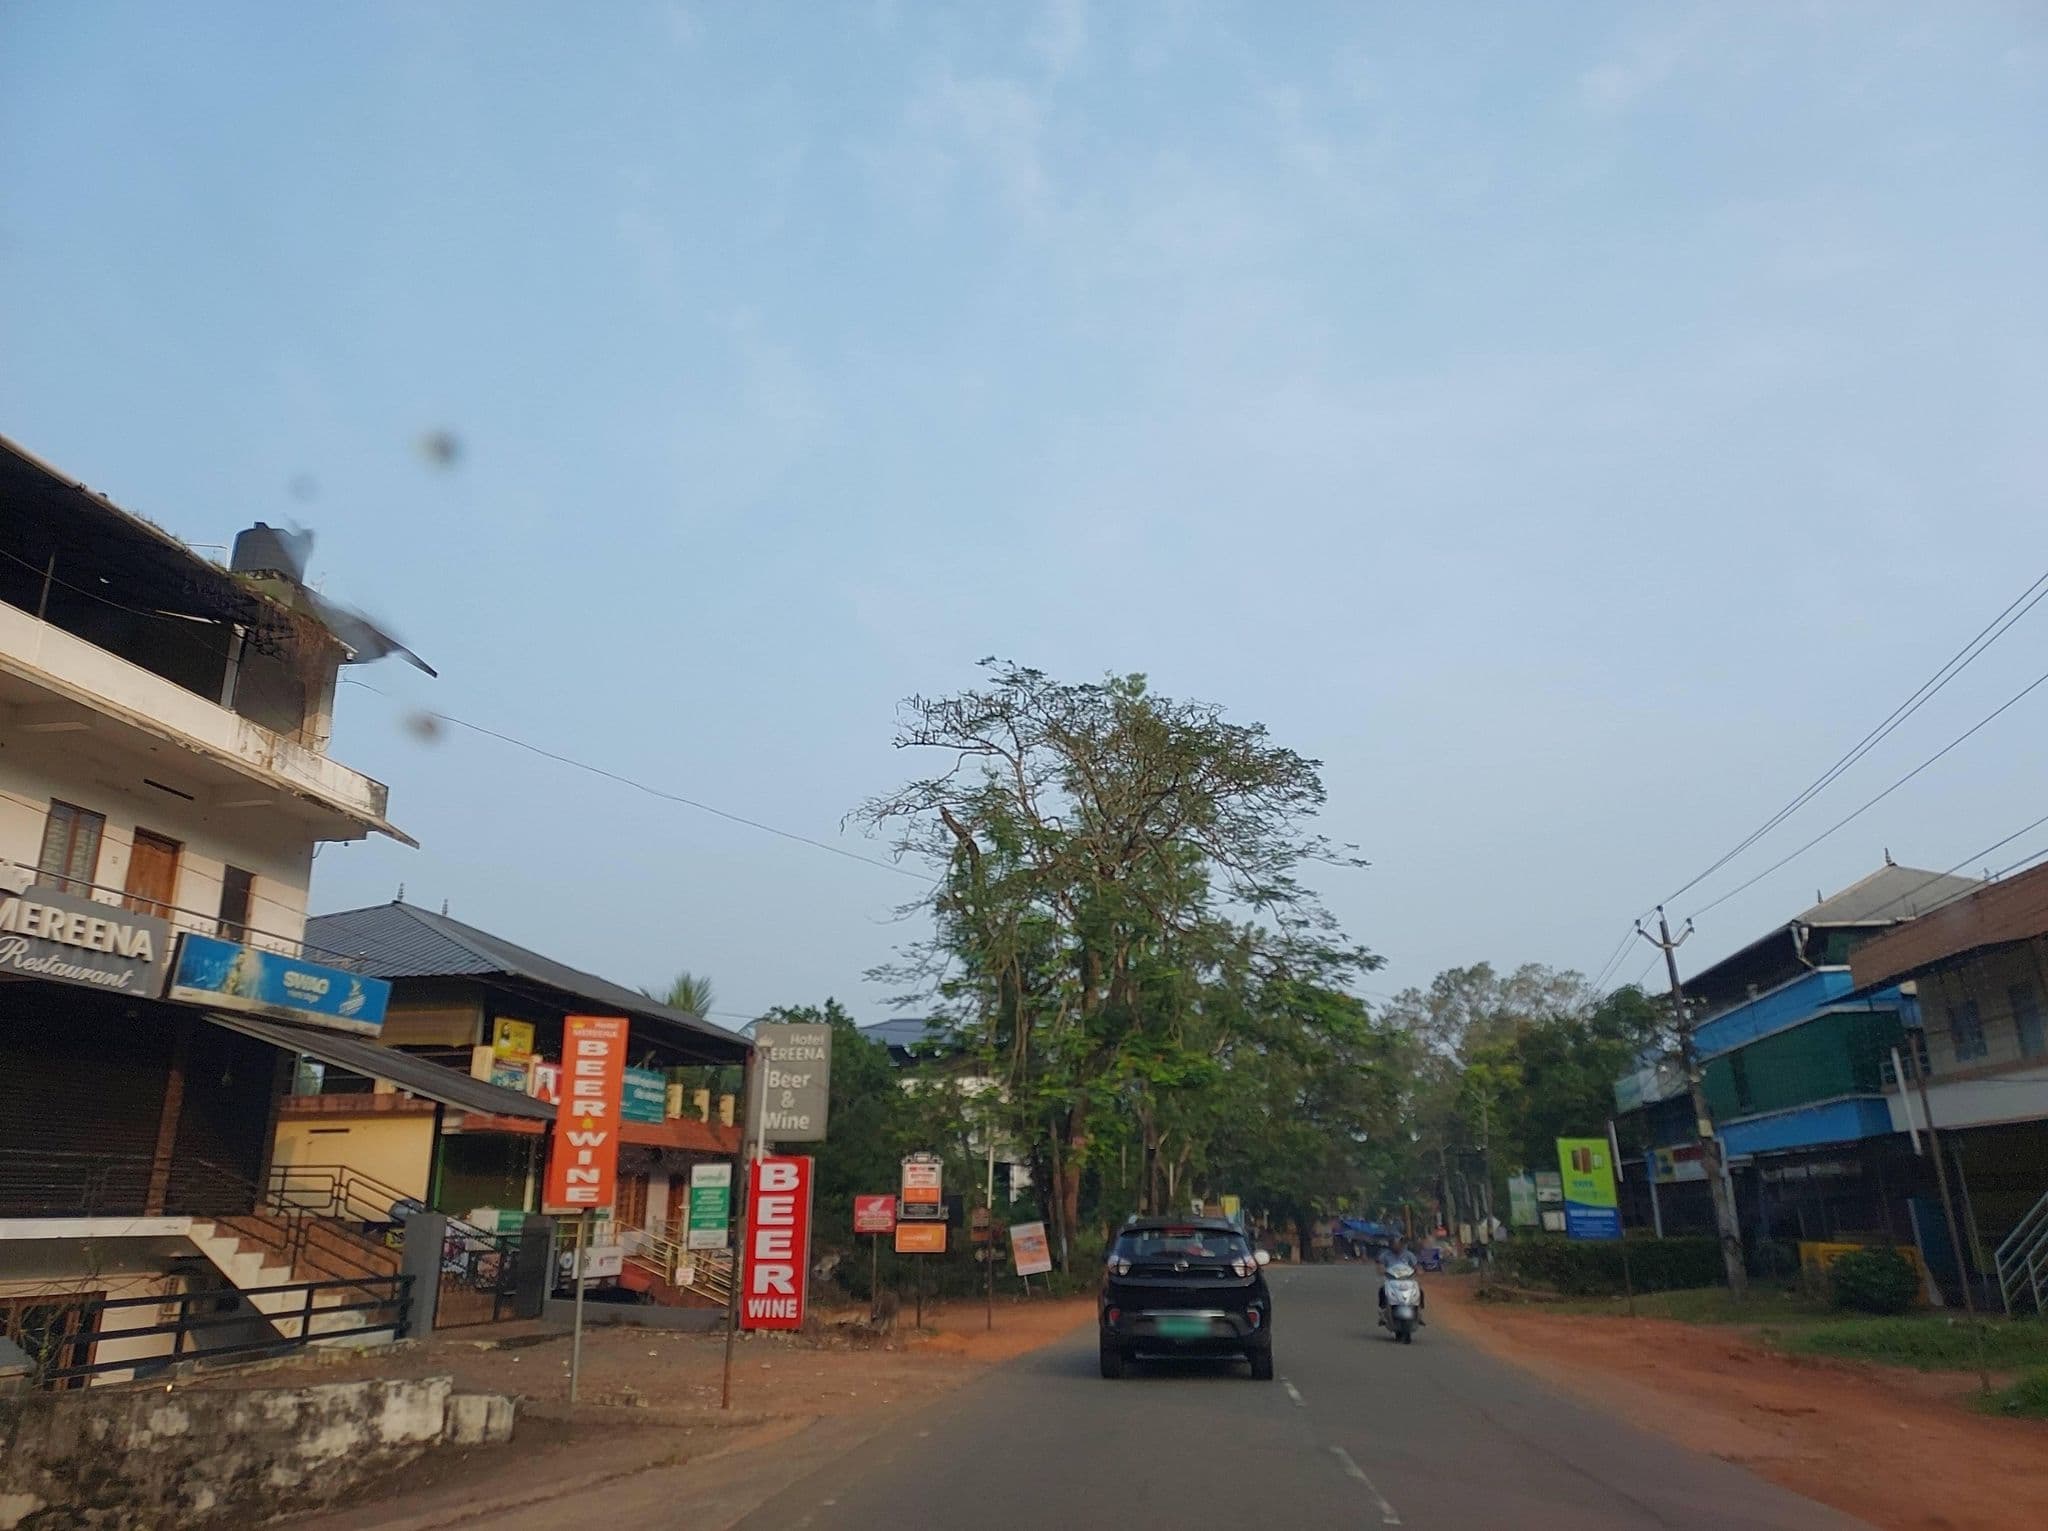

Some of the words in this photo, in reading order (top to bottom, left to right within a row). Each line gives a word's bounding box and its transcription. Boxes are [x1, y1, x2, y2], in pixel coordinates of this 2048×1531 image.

[0, 936, 134, 988] Restaurant
[790, 1033, 824, 1046] Hotel
[761, 1046, 825, 1061] EREENA
[572, 1039, 609, 1118] BEER
[769, 1071, 811, 1088] Beer
[780, 1090, 795, 1109] &
[765, 1110, 810, 1130] Wine
[565, 1131, 609, 1202] WINE
[753, 1162, 800, 1294] BEER
[748, 1299, 798, 1319] WINE
